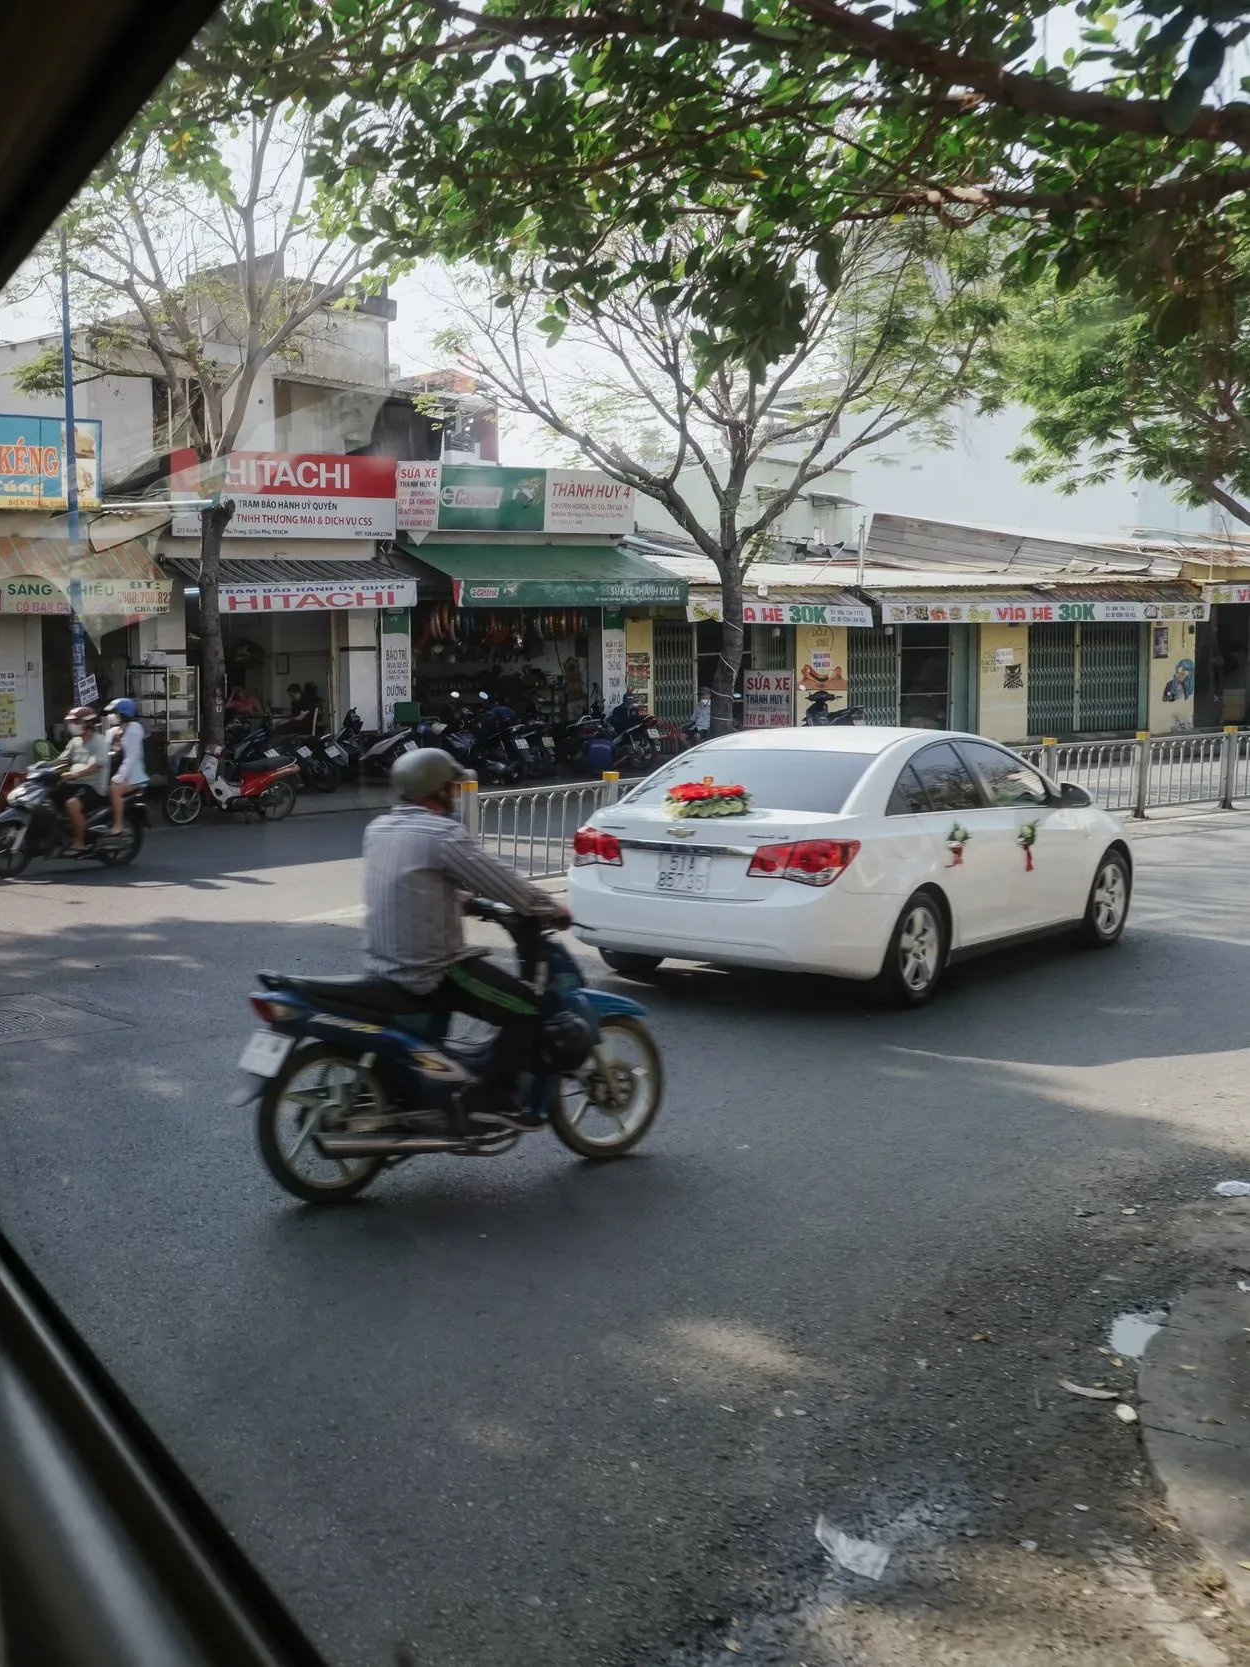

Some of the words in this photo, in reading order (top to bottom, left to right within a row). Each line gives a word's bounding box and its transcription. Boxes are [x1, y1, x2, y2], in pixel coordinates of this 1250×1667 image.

[225, 459, 350, 489] HITACHI
[401, 465, 420, 478] SỬA
[425, 468, 438, 478] XE
[420, 480, 431, 488] HUY
[551, 480, 594, 498] THÀNH
[595, 484, 622, 499] HUY
[623, 486, 630, 499] 4
[238, 499, 260, 510] TRẠM
[261, 498, 277, 509] BẢO
[278, 499, 300, 510] HÀNH
[236, 513, 261, 524] TNHH
[262, 513, 298, 524] THƯƠNG
[300, 514, 316, 526] MẠI
[317, 515, 323, 525] &
[325, 515, 344, 527] DỊCH
[346, 516, 357, 527] VỤ
[358, 517, 373, 526] CSS
[7, 581, 52, 596] SÁNG
[263, 585, 291, 594] BẢO
[296, 585, 334, 593] HÀNH
[477, 589, 497, 597] Castrol
[659, 586, 674, 597] HUY
[228, 591, 395, 611] HITACHI
[762, 606, 784, 622] HÈ
[789, 605, 828, 624] 30K
[1032, 604, 1053, 620] HÈ
[1058, 603, 1095, 621] 30K
[747, 671, 770, 690] SỬA
[775, 677, 790, 690] XE
[387, 683, 407, 696] DƯỠNG
[746, 691, 768, 704] THÀNH
[770, 694, 783, 704] HUY
[785, 694, 790, 704] 4
[746, 713, 756, 726] TAY
[758, 713, 765, 726] GA
[770, 713, 790, 726] HONDA
[670, 855, 695, 871] 51A
